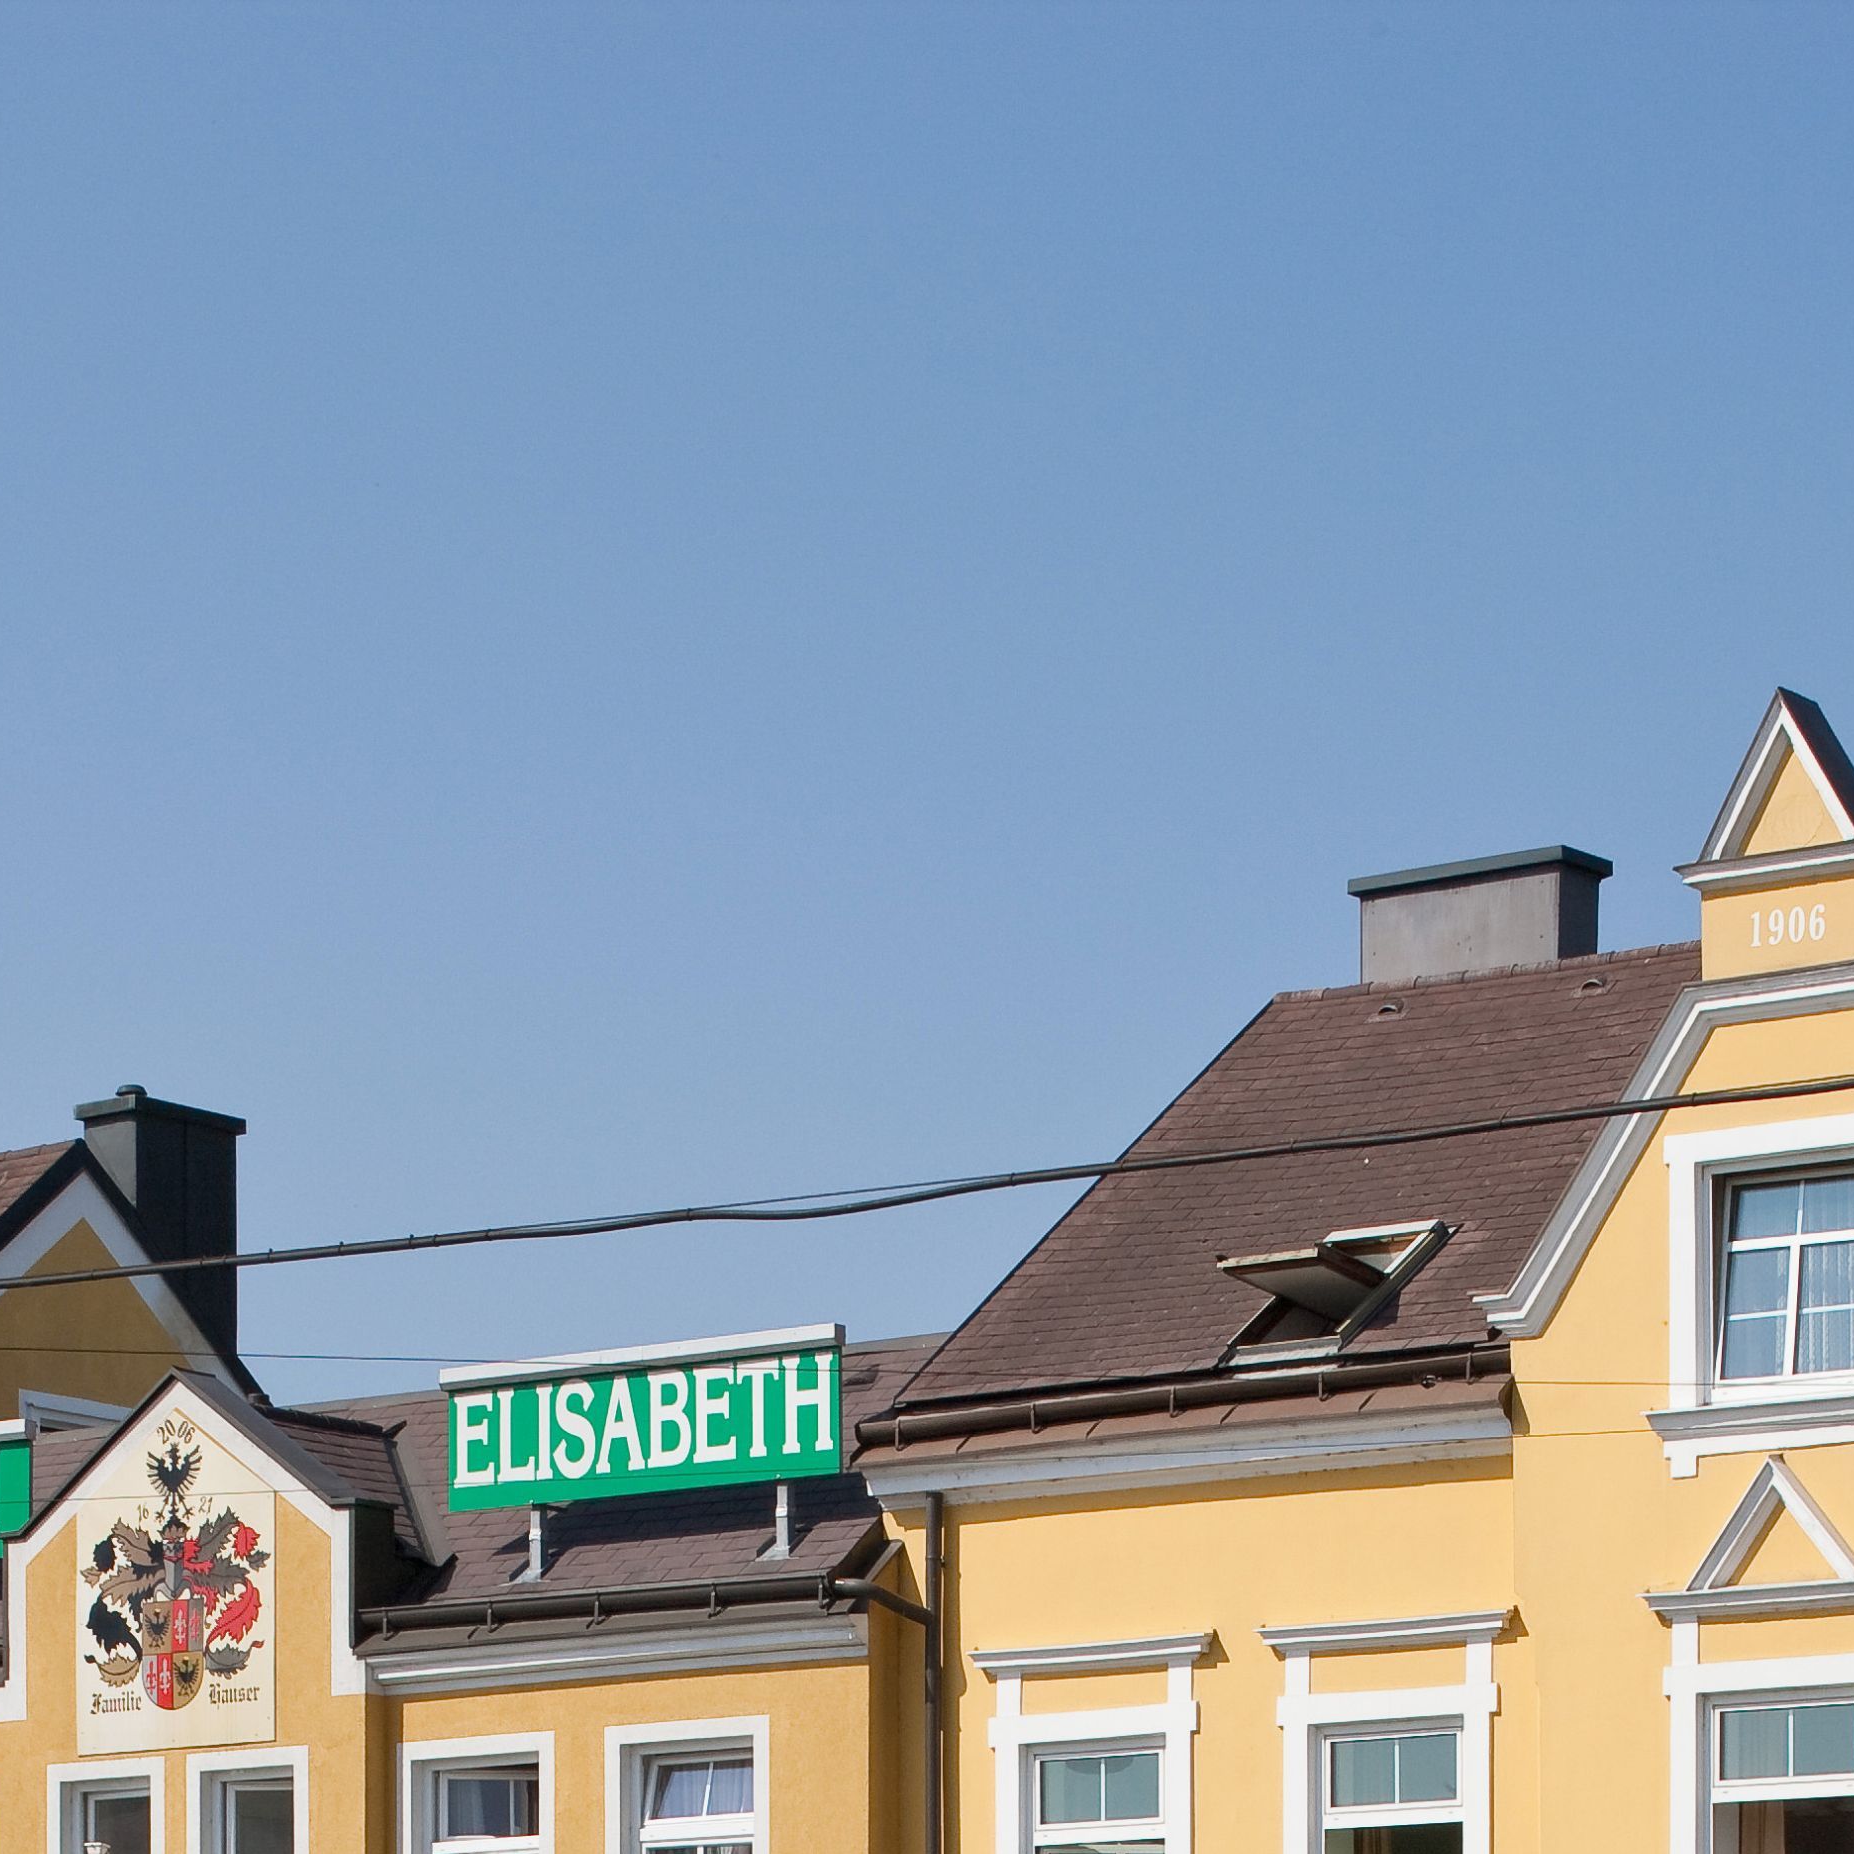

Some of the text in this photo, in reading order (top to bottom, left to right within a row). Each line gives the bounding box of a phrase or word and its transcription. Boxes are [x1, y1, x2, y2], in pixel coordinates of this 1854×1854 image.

[1750, 903, 1826, 948] 1906
[453, 1351, 834, 1489] ELISABETH
[90, 1690, 142, 1715] Familie
